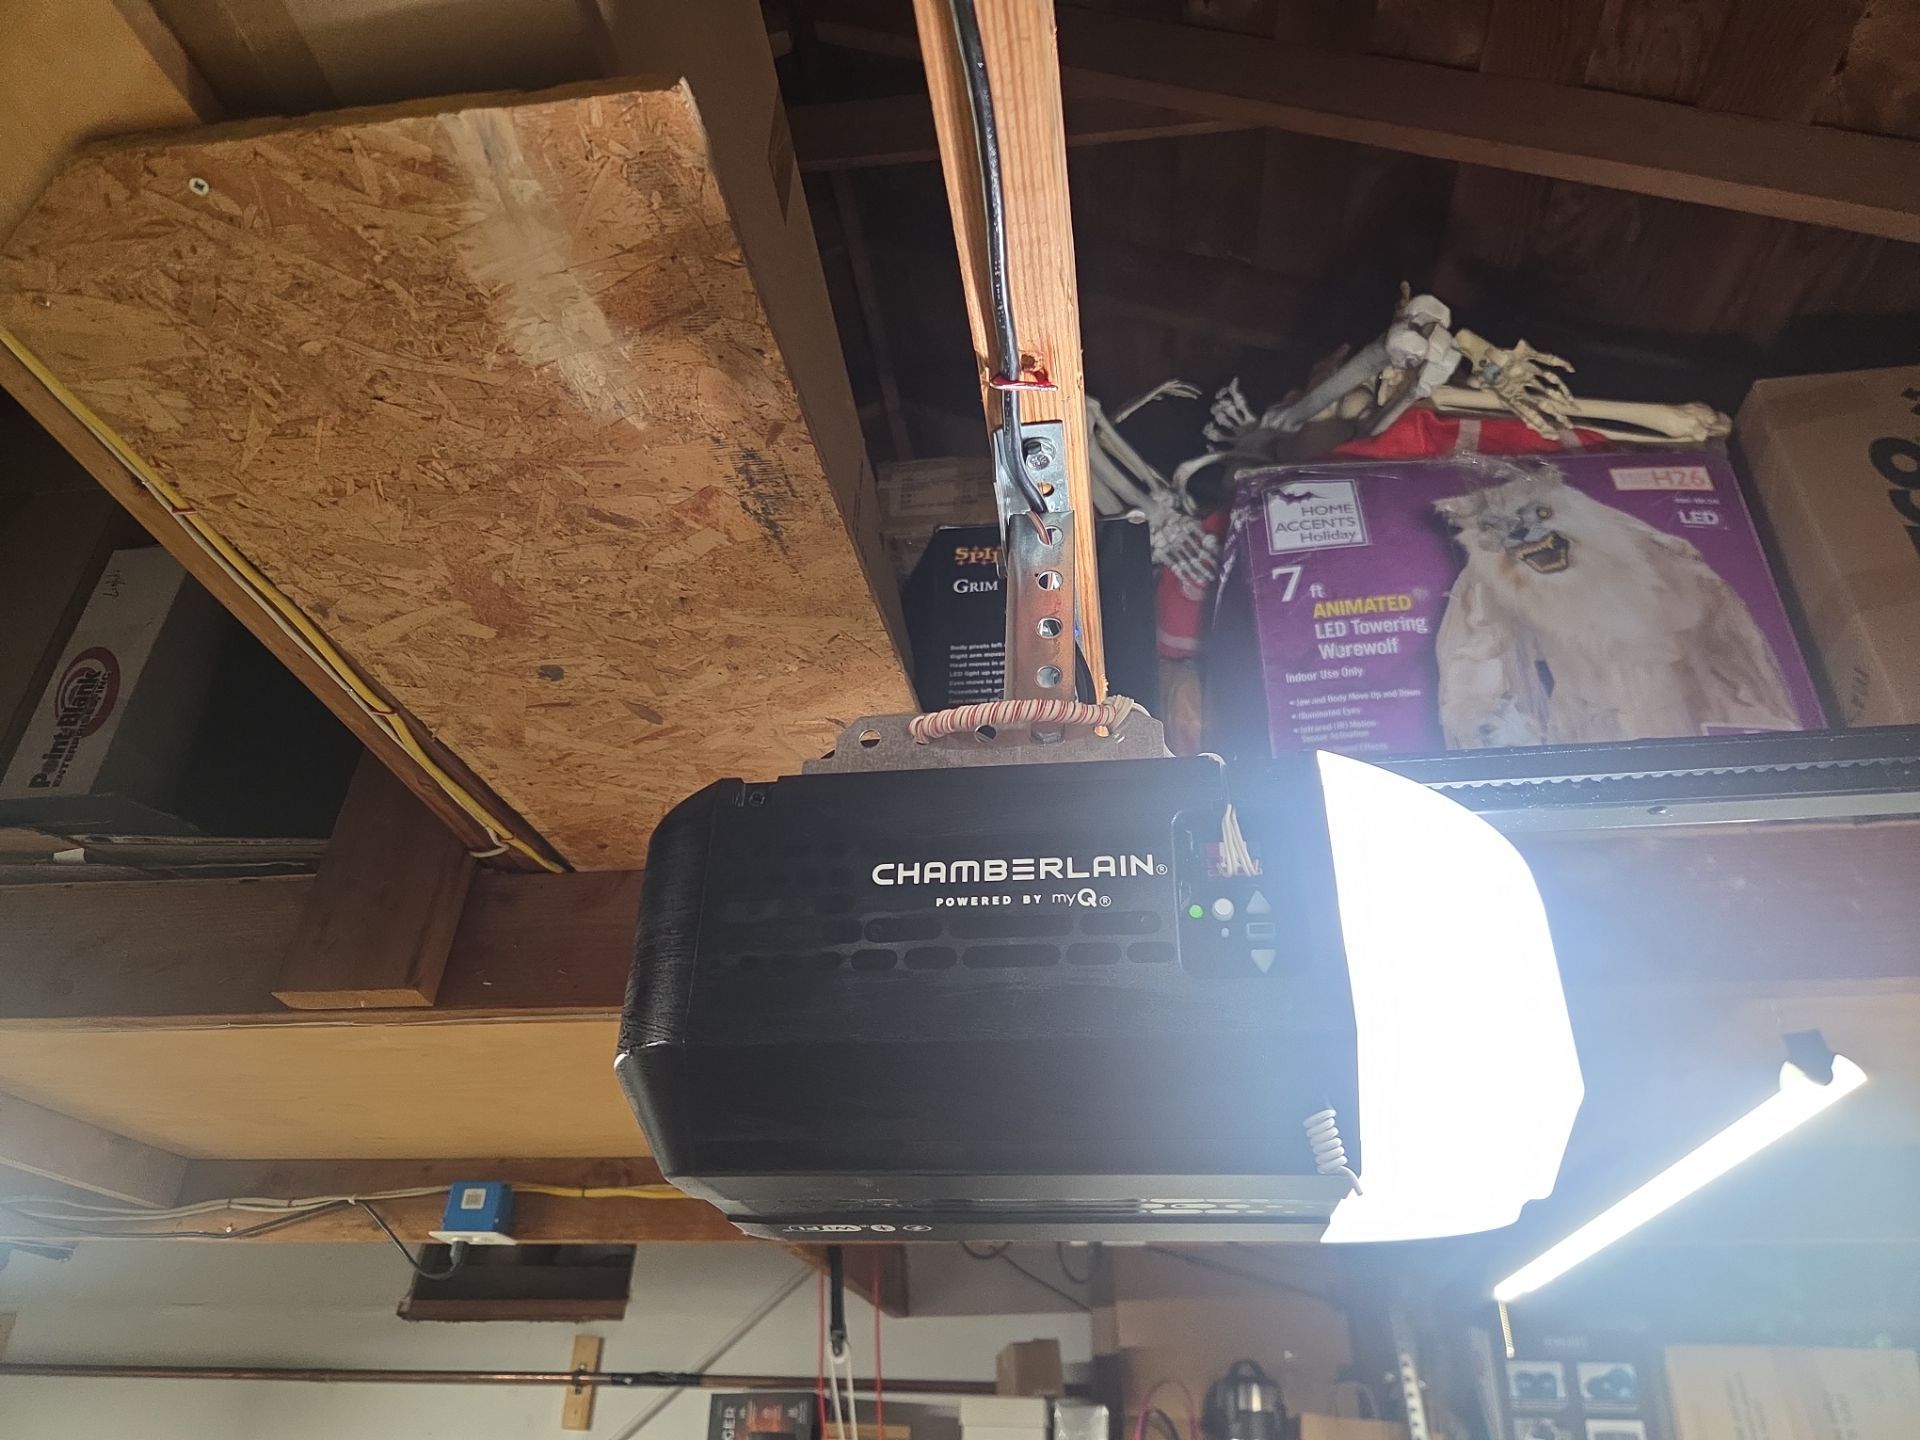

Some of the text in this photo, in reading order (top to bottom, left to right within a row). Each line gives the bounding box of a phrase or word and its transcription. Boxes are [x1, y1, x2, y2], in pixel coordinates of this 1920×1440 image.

[1651, 469, 1706, 487] H26
[1301, 504, 1354, 517] HOME
[1677, 509, 1720, 526] LED
[1274, 517, 1356, 533] ACCENTS
[1300, 530, 1356, 543] Holiday
[1271, 566, 1325, 602] 7 ft
[1313, 595, 1412, 618] ANIMATED
[1315, 616, 1428, 639] LED Towering
[1318, 637, 1399, 660] Werewolf
[1285, 666, 1363, 683] Indoor Use Only
[56, 671, 101, 727] Blank
[1328, 694, 1347, 703] Body
[1343, 706, 1361, 716] Eyes
[936, 895, 1012, 907] POWERED
[1023, 894, 1042, 904] BY
